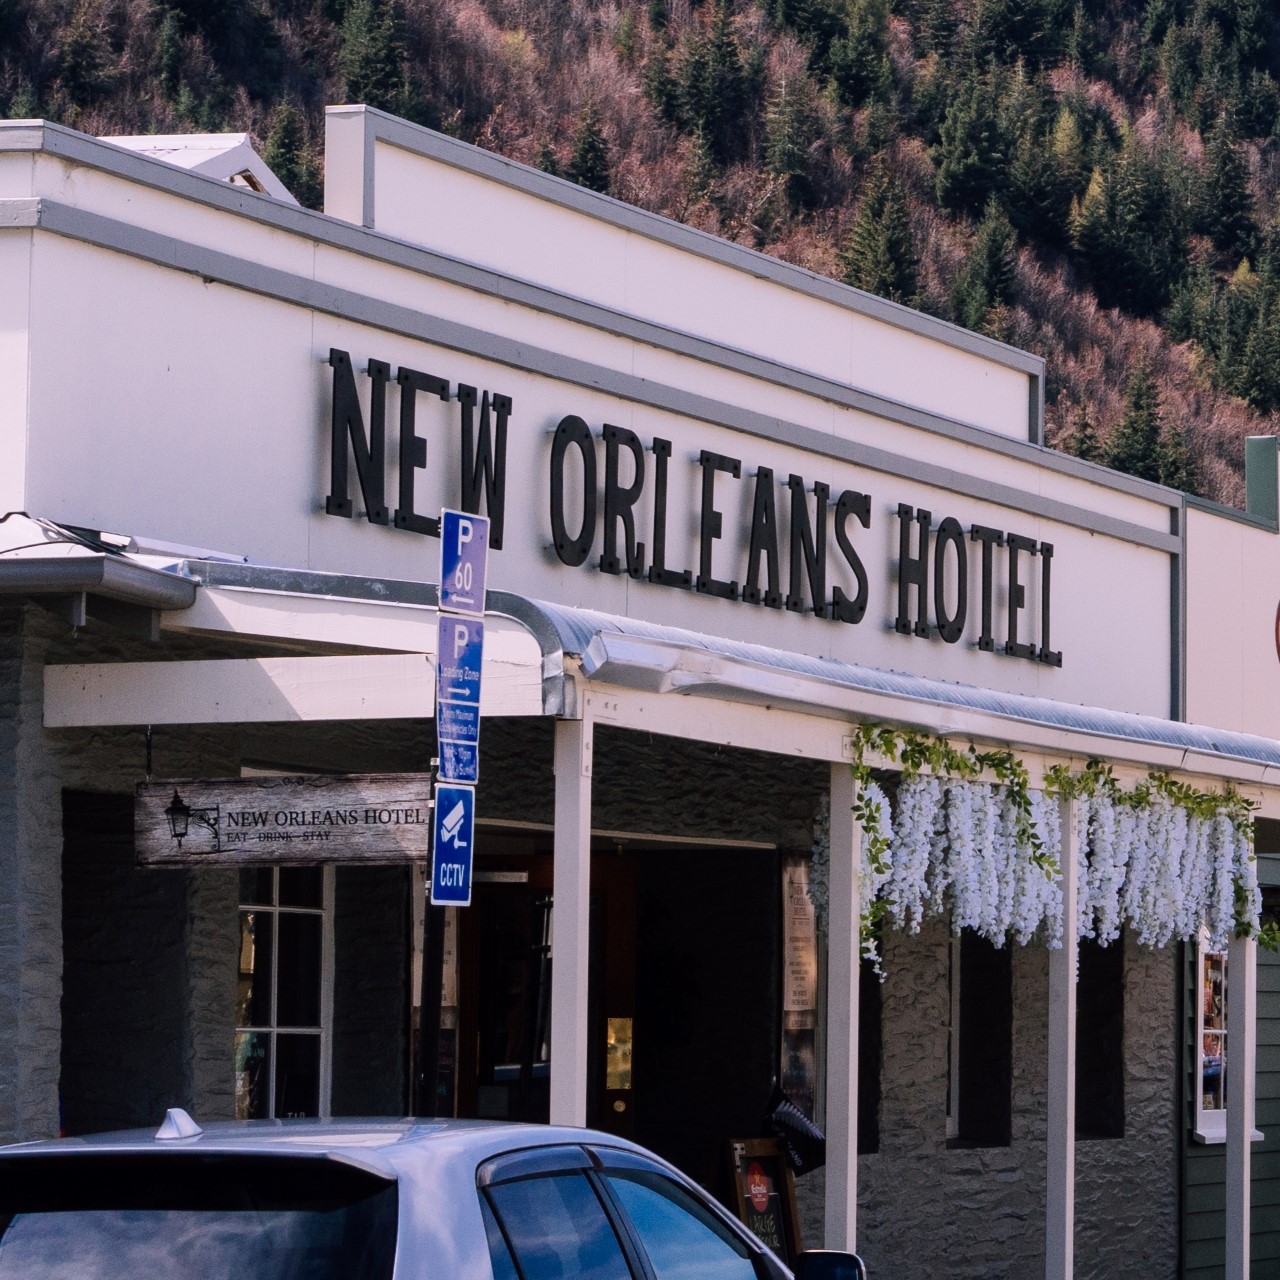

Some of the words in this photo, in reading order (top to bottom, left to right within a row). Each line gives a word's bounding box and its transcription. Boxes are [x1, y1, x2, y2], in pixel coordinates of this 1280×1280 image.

[326, 348, 513, 550] NEW
[550, 414, 872, 624] ORLEANS
[895, 502, 1063, 668] HOTEL
[457, 519, 474, 556] P
[454, 562, 472, 591] 60
[453, 624, 469, 659] P
[440, 664, 463, 681] Loading
[464, 666, 480, 681] Zone
[227, 811, 270, 827] NEW
[274, 809, 360, 826] ORLEANS
[364, 808, 425, 824] HOTEL
[227, 832, 247, 842] EAT
[258, 832, 293, 842] DRINK
[302, 831, 331, 841] STAY
[440, 863, 464, 887] CCTV
